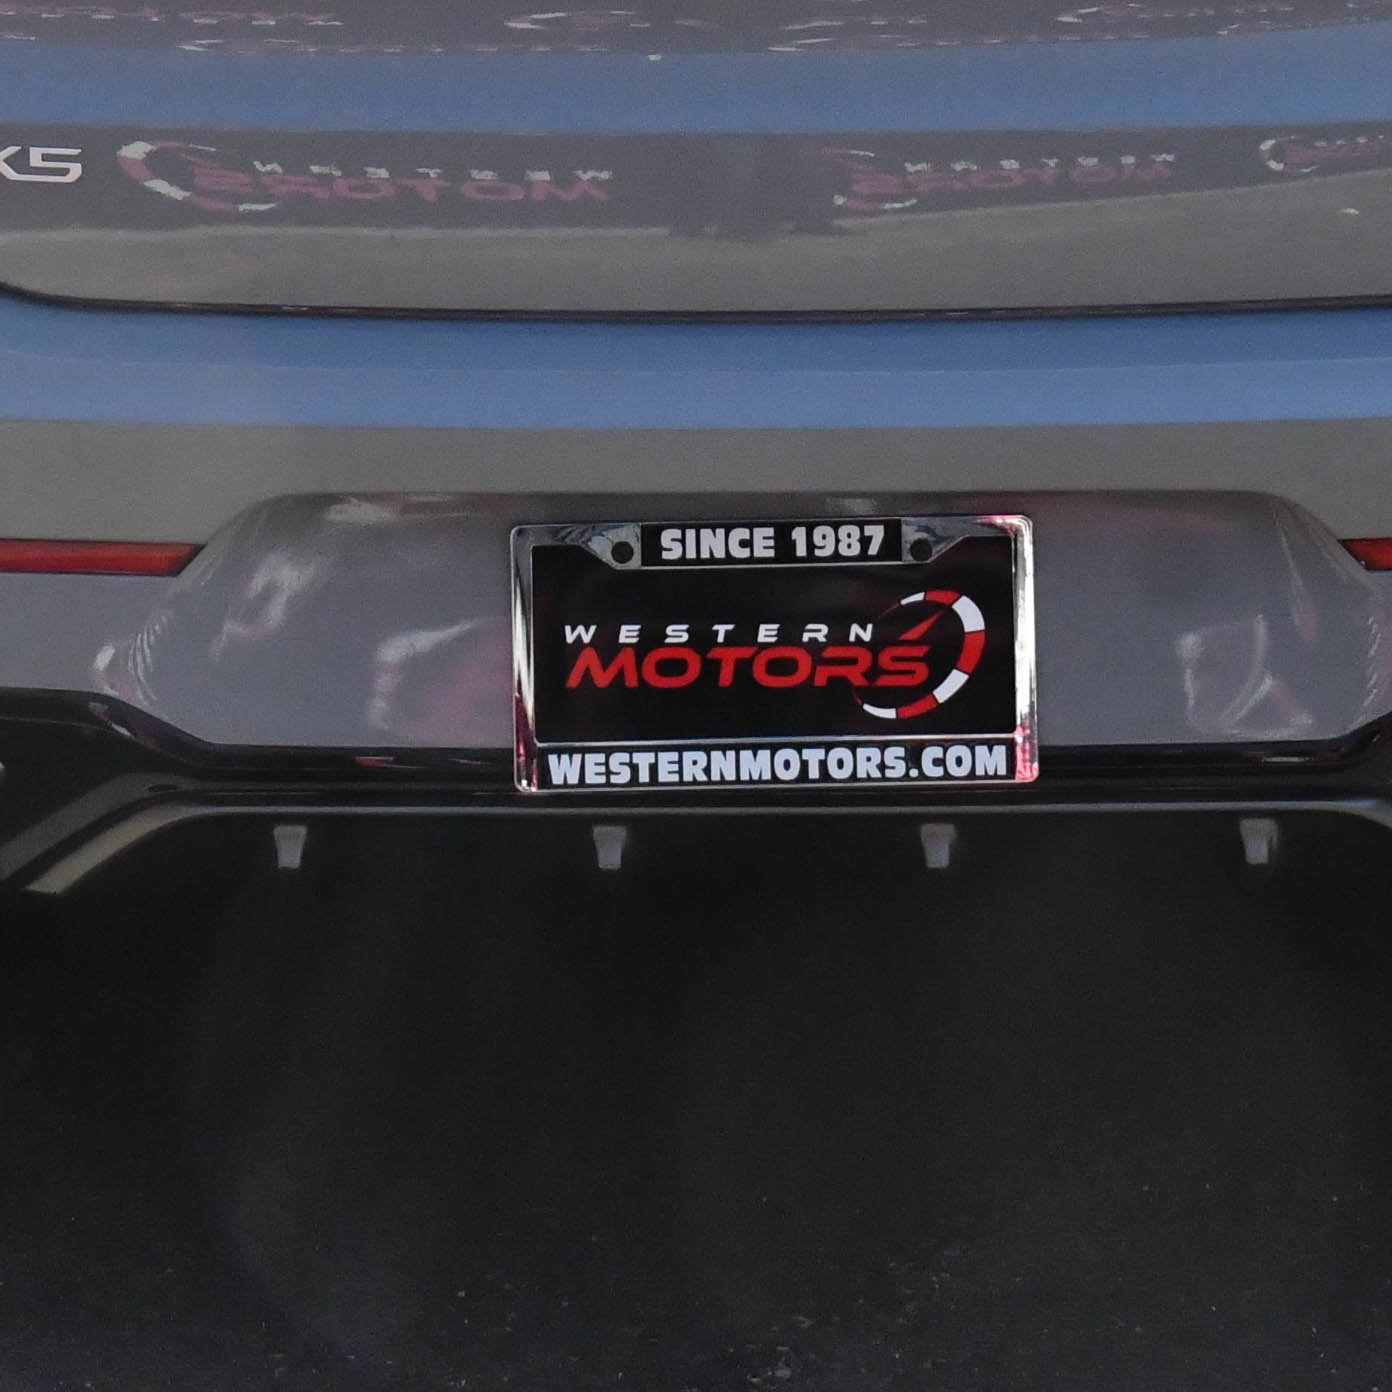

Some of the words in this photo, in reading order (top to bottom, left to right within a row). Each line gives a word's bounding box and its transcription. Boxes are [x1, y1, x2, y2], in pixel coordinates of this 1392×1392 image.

[660, 526, 776, 560] SINCE
[791, 524, 885, 557] 1987
[564, 623, 874, 644] WESTERN
[565, 645, 931, 689] MOTORS
[547, 743, 1008, 786] WESTERNMOTORS.COM
